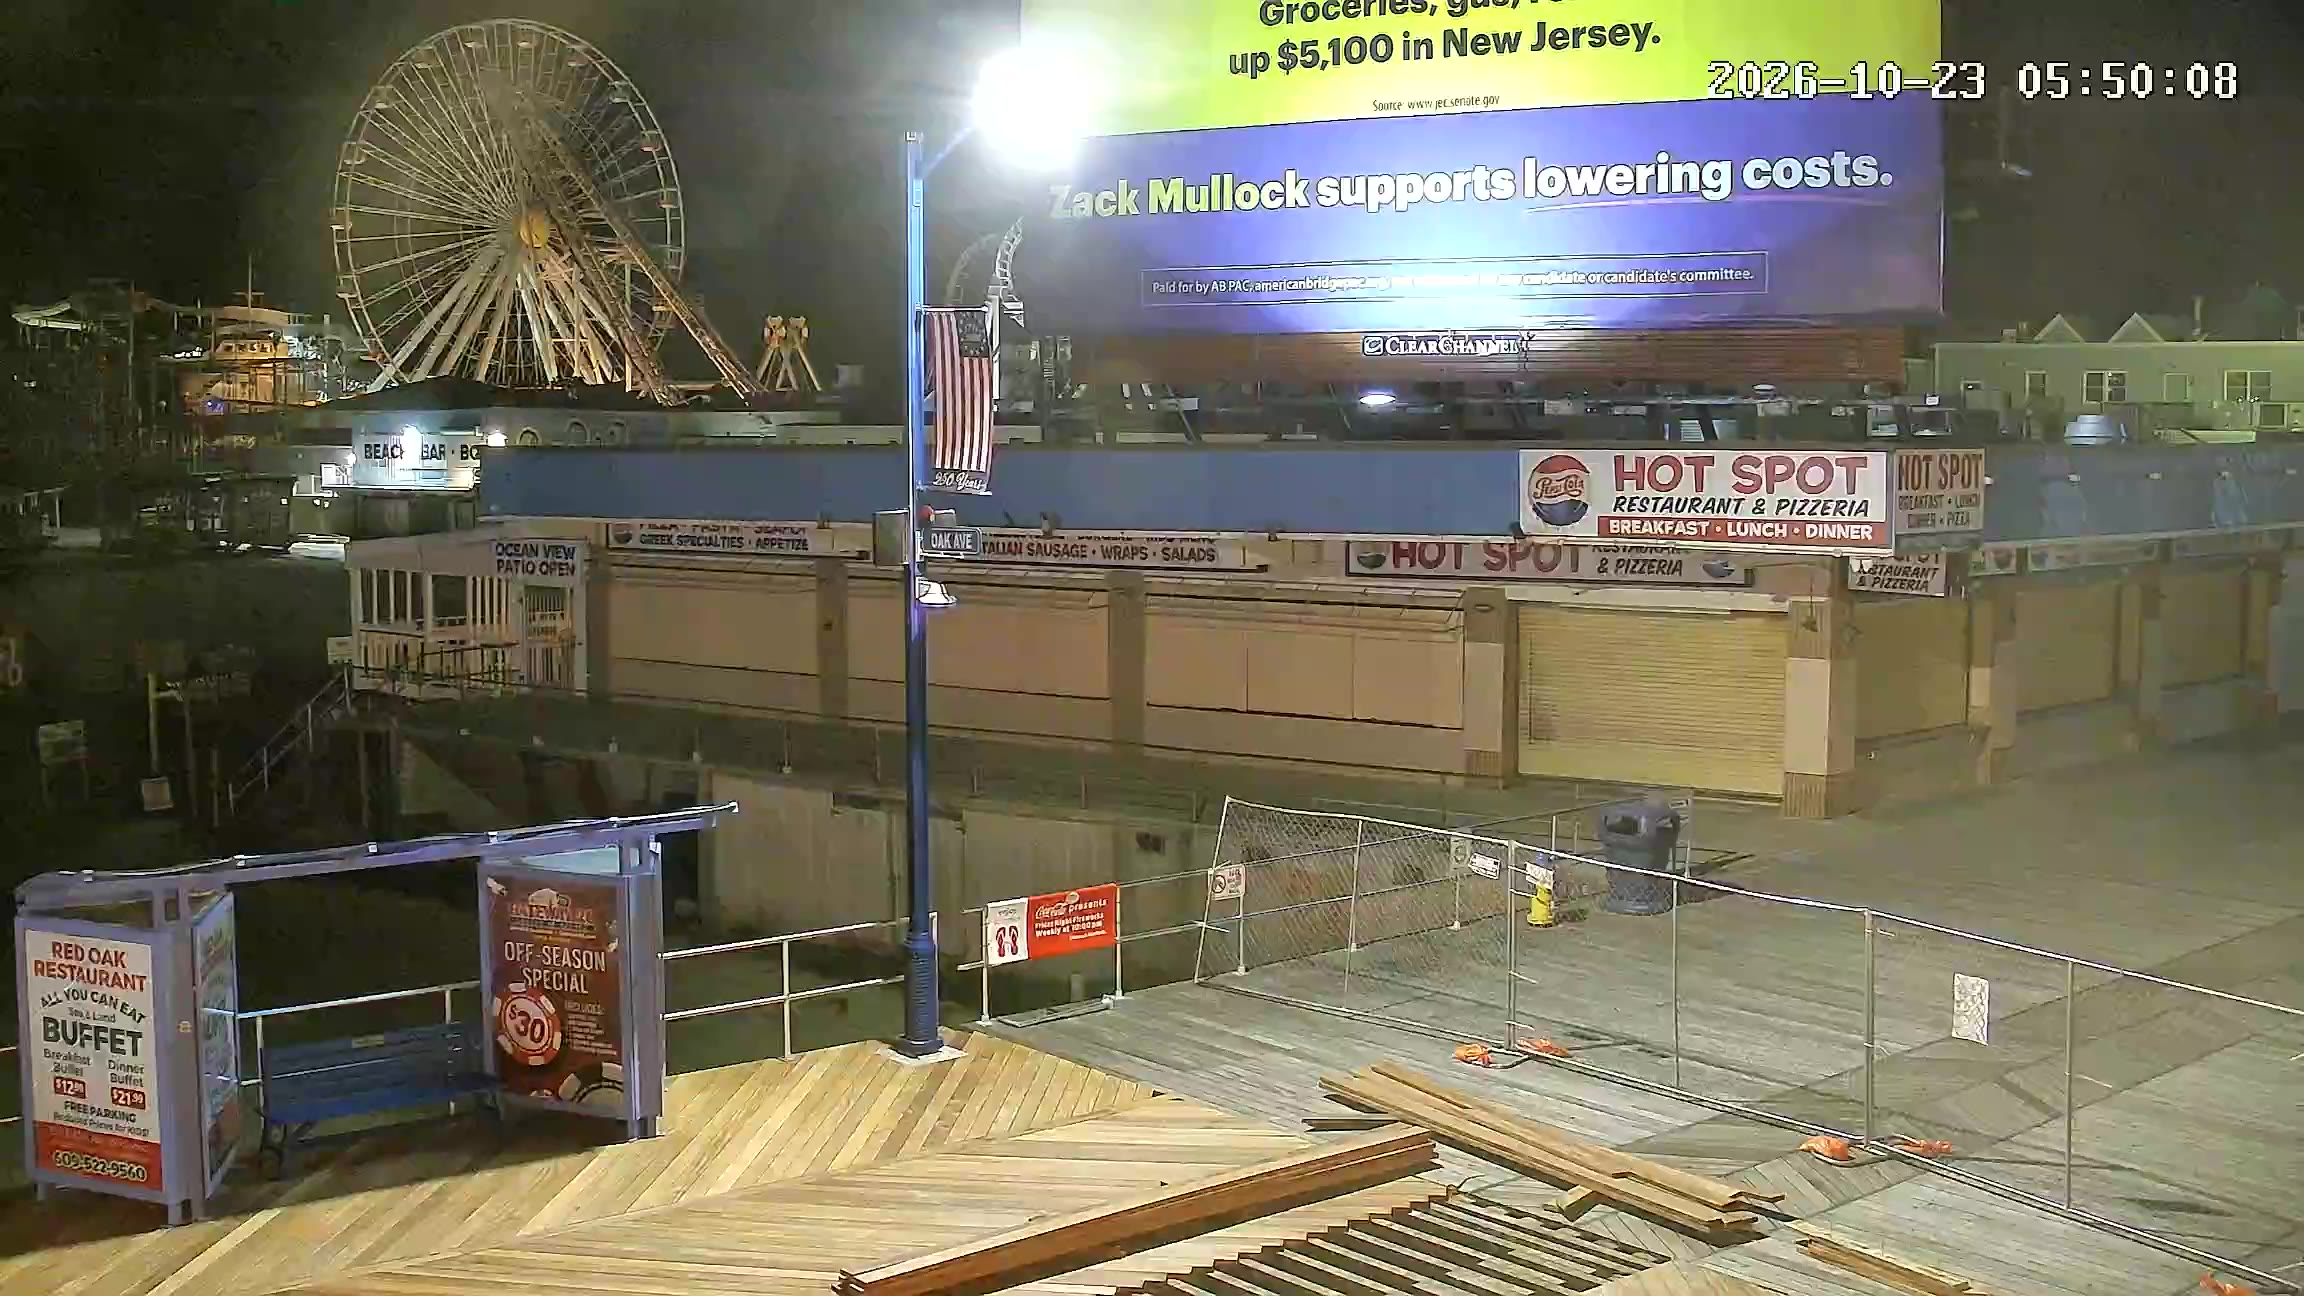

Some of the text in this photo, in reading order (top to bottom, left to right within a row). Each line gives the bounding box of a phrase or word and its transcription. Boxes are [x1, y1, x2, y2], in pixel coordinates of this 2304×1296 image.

[1228, 21, 1661, 79] up $5,100 in New Jersey.
[1049, 150, 1893, 218] Zack Mullock supports lowering costs.
[1152, 281, 1176, 293] Paid
[1178, 280, 1194, 293] for
[1195, 280, 1209, 295] by
[1211, 279, 1226, 292] AB
[1587, 272, 1602, 284] or
[1603, 268, 1677, 284] candidate's
[1680, 268, 1755, 282] committee.
[364, 443, 406, 460] BEAC
[421, 443, 446, 461] BAR
[1614, 454, 1868, 495] HOT SPOT
[1938, 453, 1982, 490] SPOT
[1613, 495, 1869, 518] RESTAURANT & PIZZERIA
[931, 532, 953, 548] OAK
[953, 532, 973, 549] AVE
[1609, 519, 1873, 541] BREAKFAST LUNCH DINNER
[496, 543, 577, 560] OCEAN VIEW
[1027, 541, 1088, 559] SAUSAGE
[1100, 544, 1149, 561] WRAPS
[1161, 546, 1216, 563] SALADS
[1393, 541, 1580, 573] HOT SPOT
[496, 559, 576, 577] PATIO OPEN
[1597, 557, 1683, 576] & PIZZERIA
[1871, 576, 1930, 592] PIZZERIA
[52, 941, 129, 969] RED OAK
[33, 960, 147, 992] RESTAURANT
[522, 967, 588, 994] SPECIAL
[41, 988, 147, 1024] ALL YOU CAN EAT
[43, 1016, 143, 1056] BUFFET
[508, 1003, 546, 1043] $30
[107, 1059, 145, 1075] Dinner
[64, 1100, 137, 1123] FREE PARKING
[53, 1150, 147, 1182] 609-522-9560
